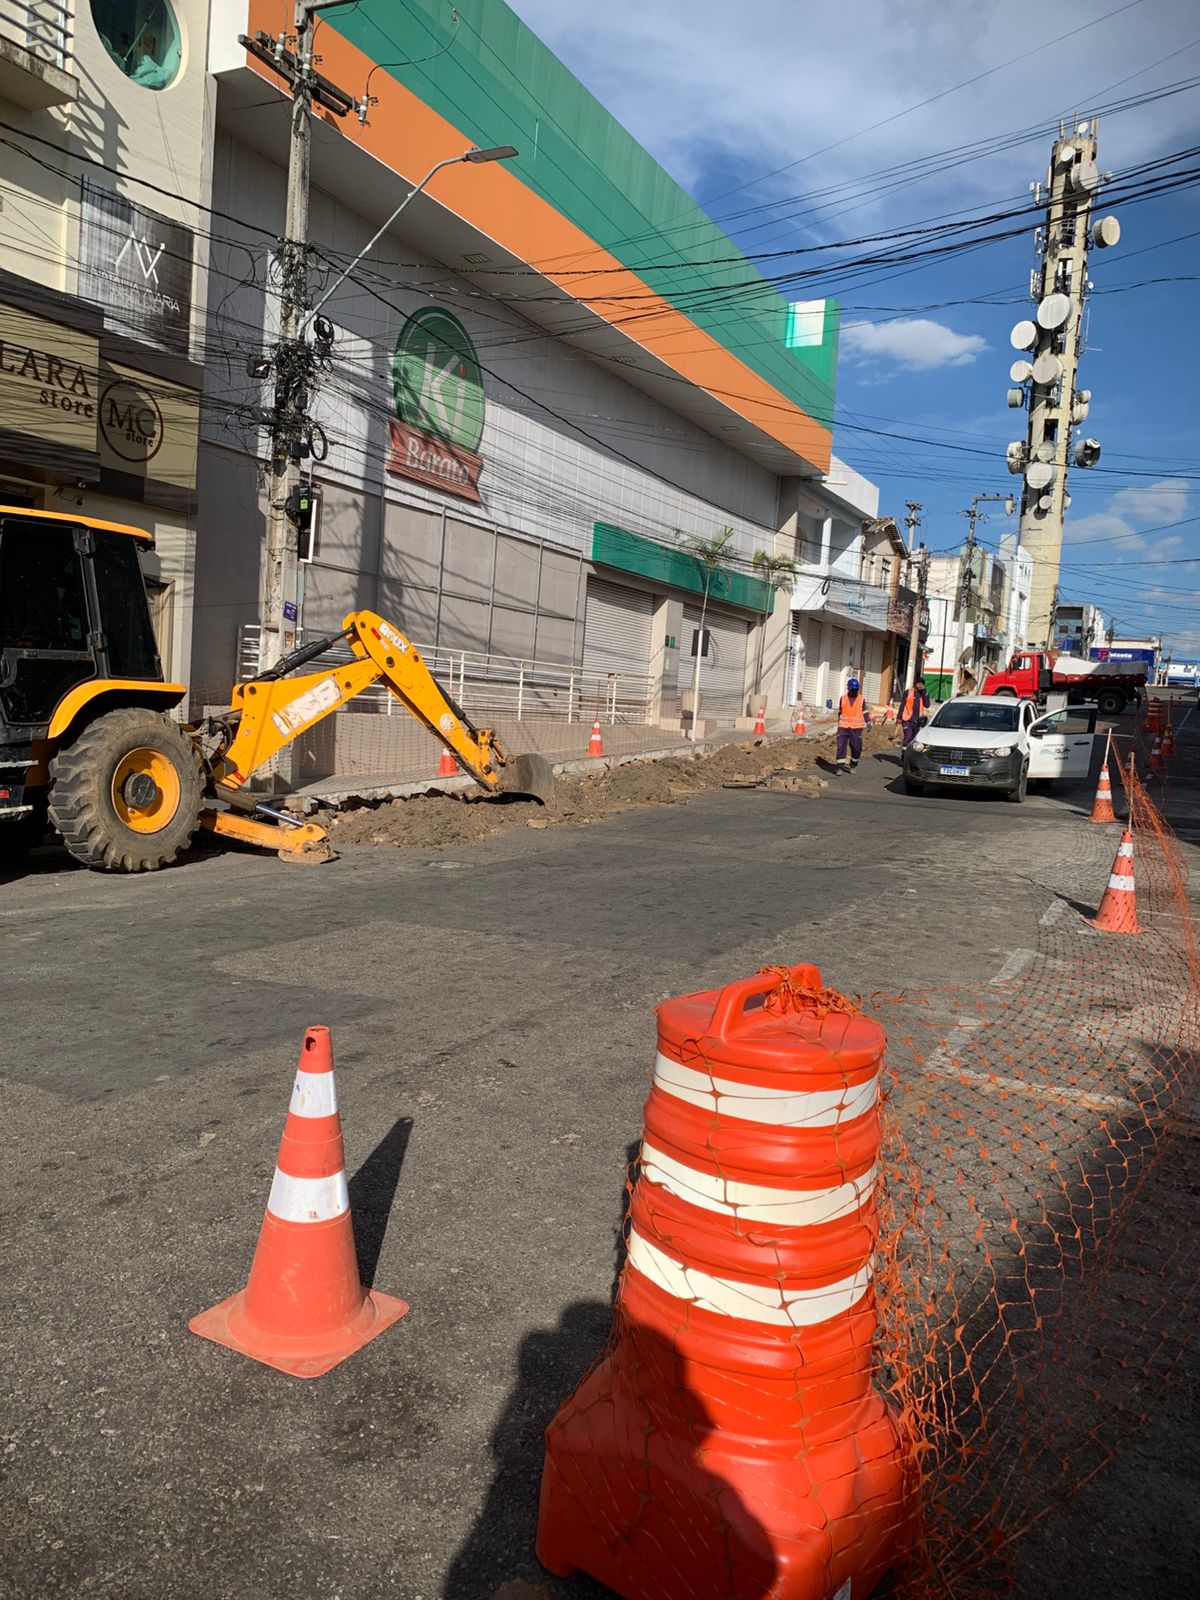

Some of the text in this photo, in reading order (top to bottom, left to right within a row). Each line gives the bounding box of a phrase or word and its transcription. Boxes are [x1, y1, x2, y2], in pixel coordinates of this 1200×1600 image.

[39, 389, 94, 418] store
[106, 398, 157, 438] MC
[126, 431, 154, 448] store
